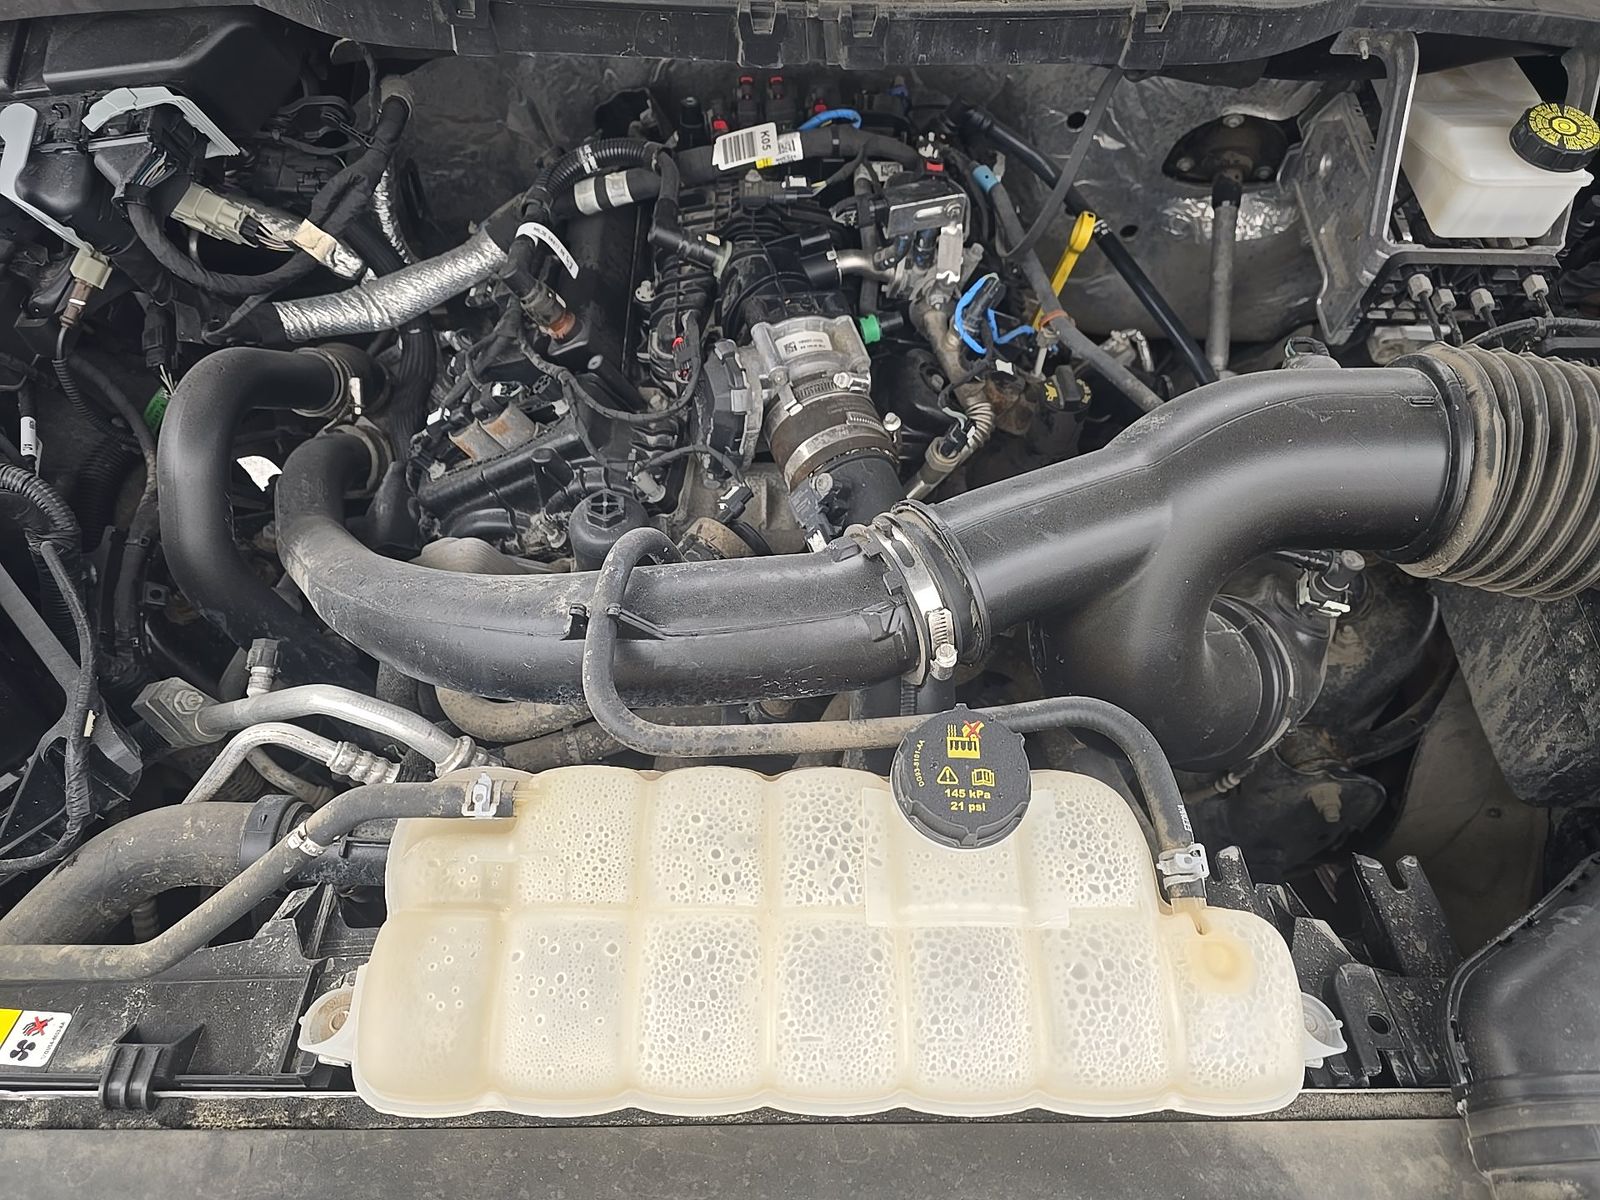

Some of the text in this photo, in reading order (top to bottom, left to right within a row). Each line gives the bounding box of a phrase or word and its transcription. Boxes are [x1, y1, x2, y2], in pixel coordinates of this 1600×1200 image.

[760, 130, 772, 151] K05
[944, 788, 991, 799] 145 kPa
[950, 801, 986, 813] 21 psi
